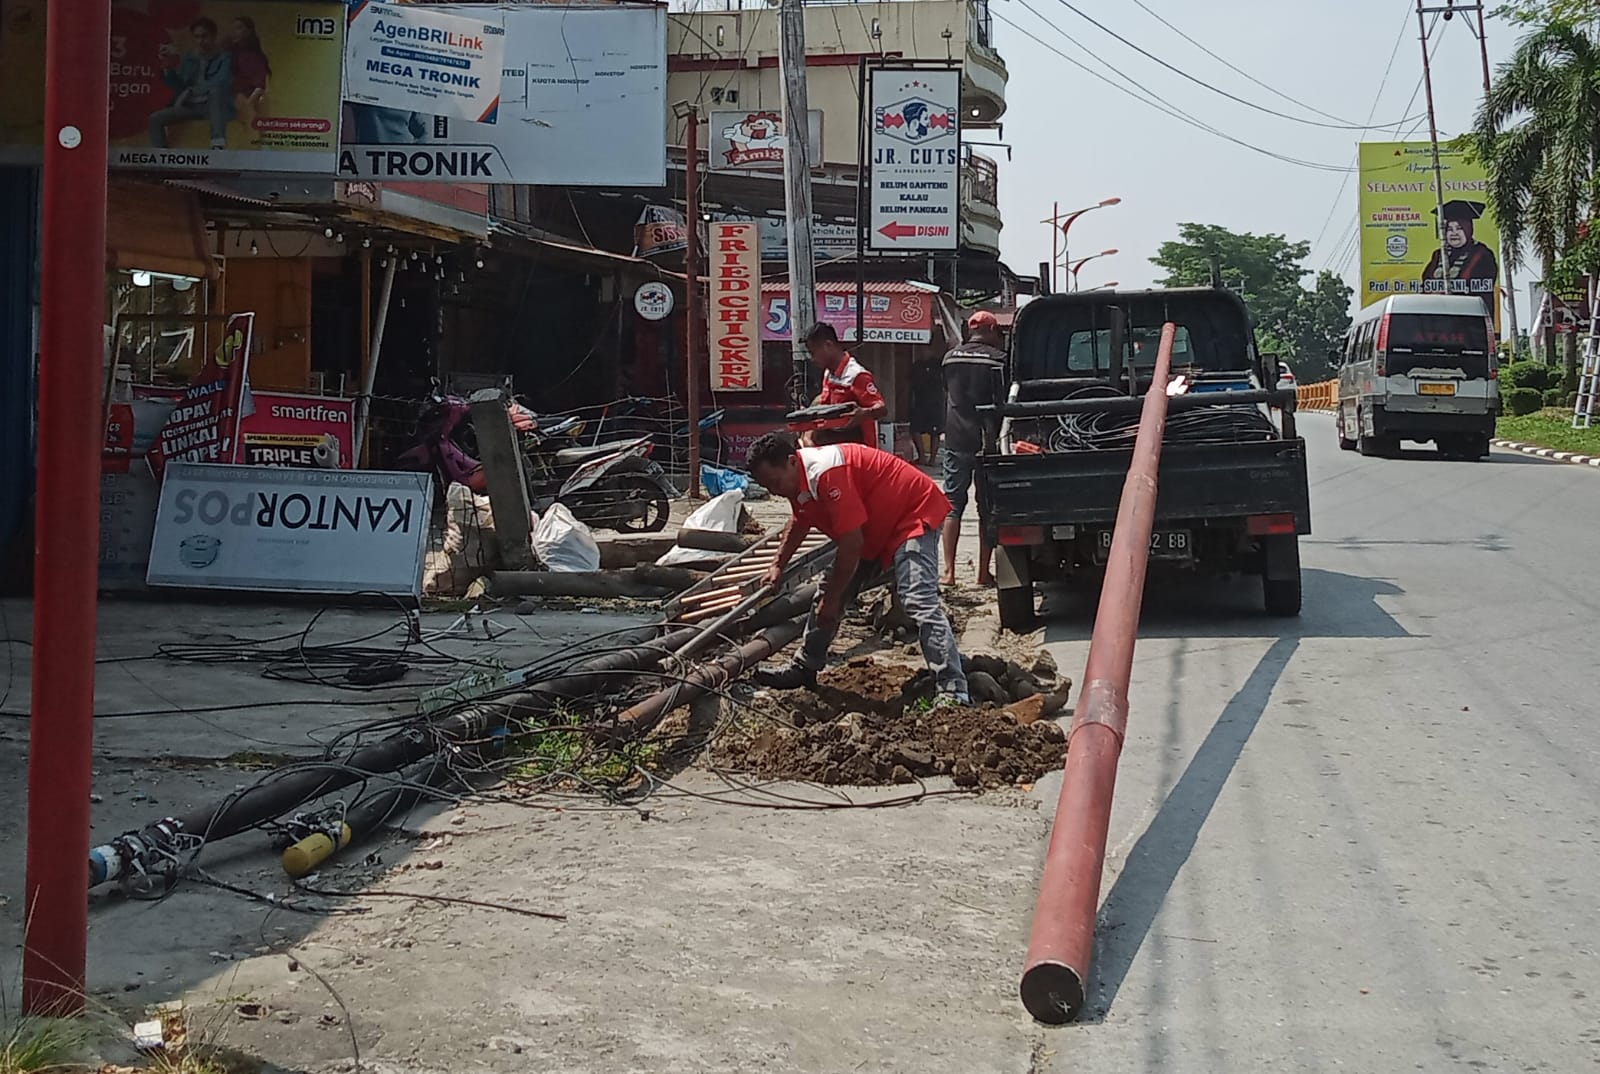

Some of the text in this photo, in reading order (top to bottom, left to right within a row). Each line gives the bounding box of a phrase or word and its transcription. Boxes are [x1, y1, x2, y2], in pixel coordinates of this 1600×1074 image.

[373, 19, 484, 51] AgenBRILink
[366, 59, 414, 78] MEGA
[419, 68, 481, 88] TRONIK
[119, 154, 209, 165] MEGA TRONIK
[366, 151, 492, 176] TRONIK
[735, 150, 785, 164] Amig
[875, 148, 956, 164] JR. CUTS
[1367, 182, 1424, 192] SELAMAT
[1444, 181, 1488, 191] SUKSE
[1372, 213, 1421, 221] GURU BESAR
[917, 226, 949, 237] DISINI
[718, 226, 750, 291] FRIED
[1369, 281, 1391, 291] Prof.
[1394, 281, 1406, 291] Dr.
[1410, 281, 1424, 294] Hj.
[1425, 280, 1469, 294] SURANI,
[718, 296, 750, 388] CHICKEN
[895, 331, 923, 341] CELL
[166, 400, 212, 425] OPAY
[272, 405, 347, 423] smartfren
[251, 448, 312, 464] TRIPLE
